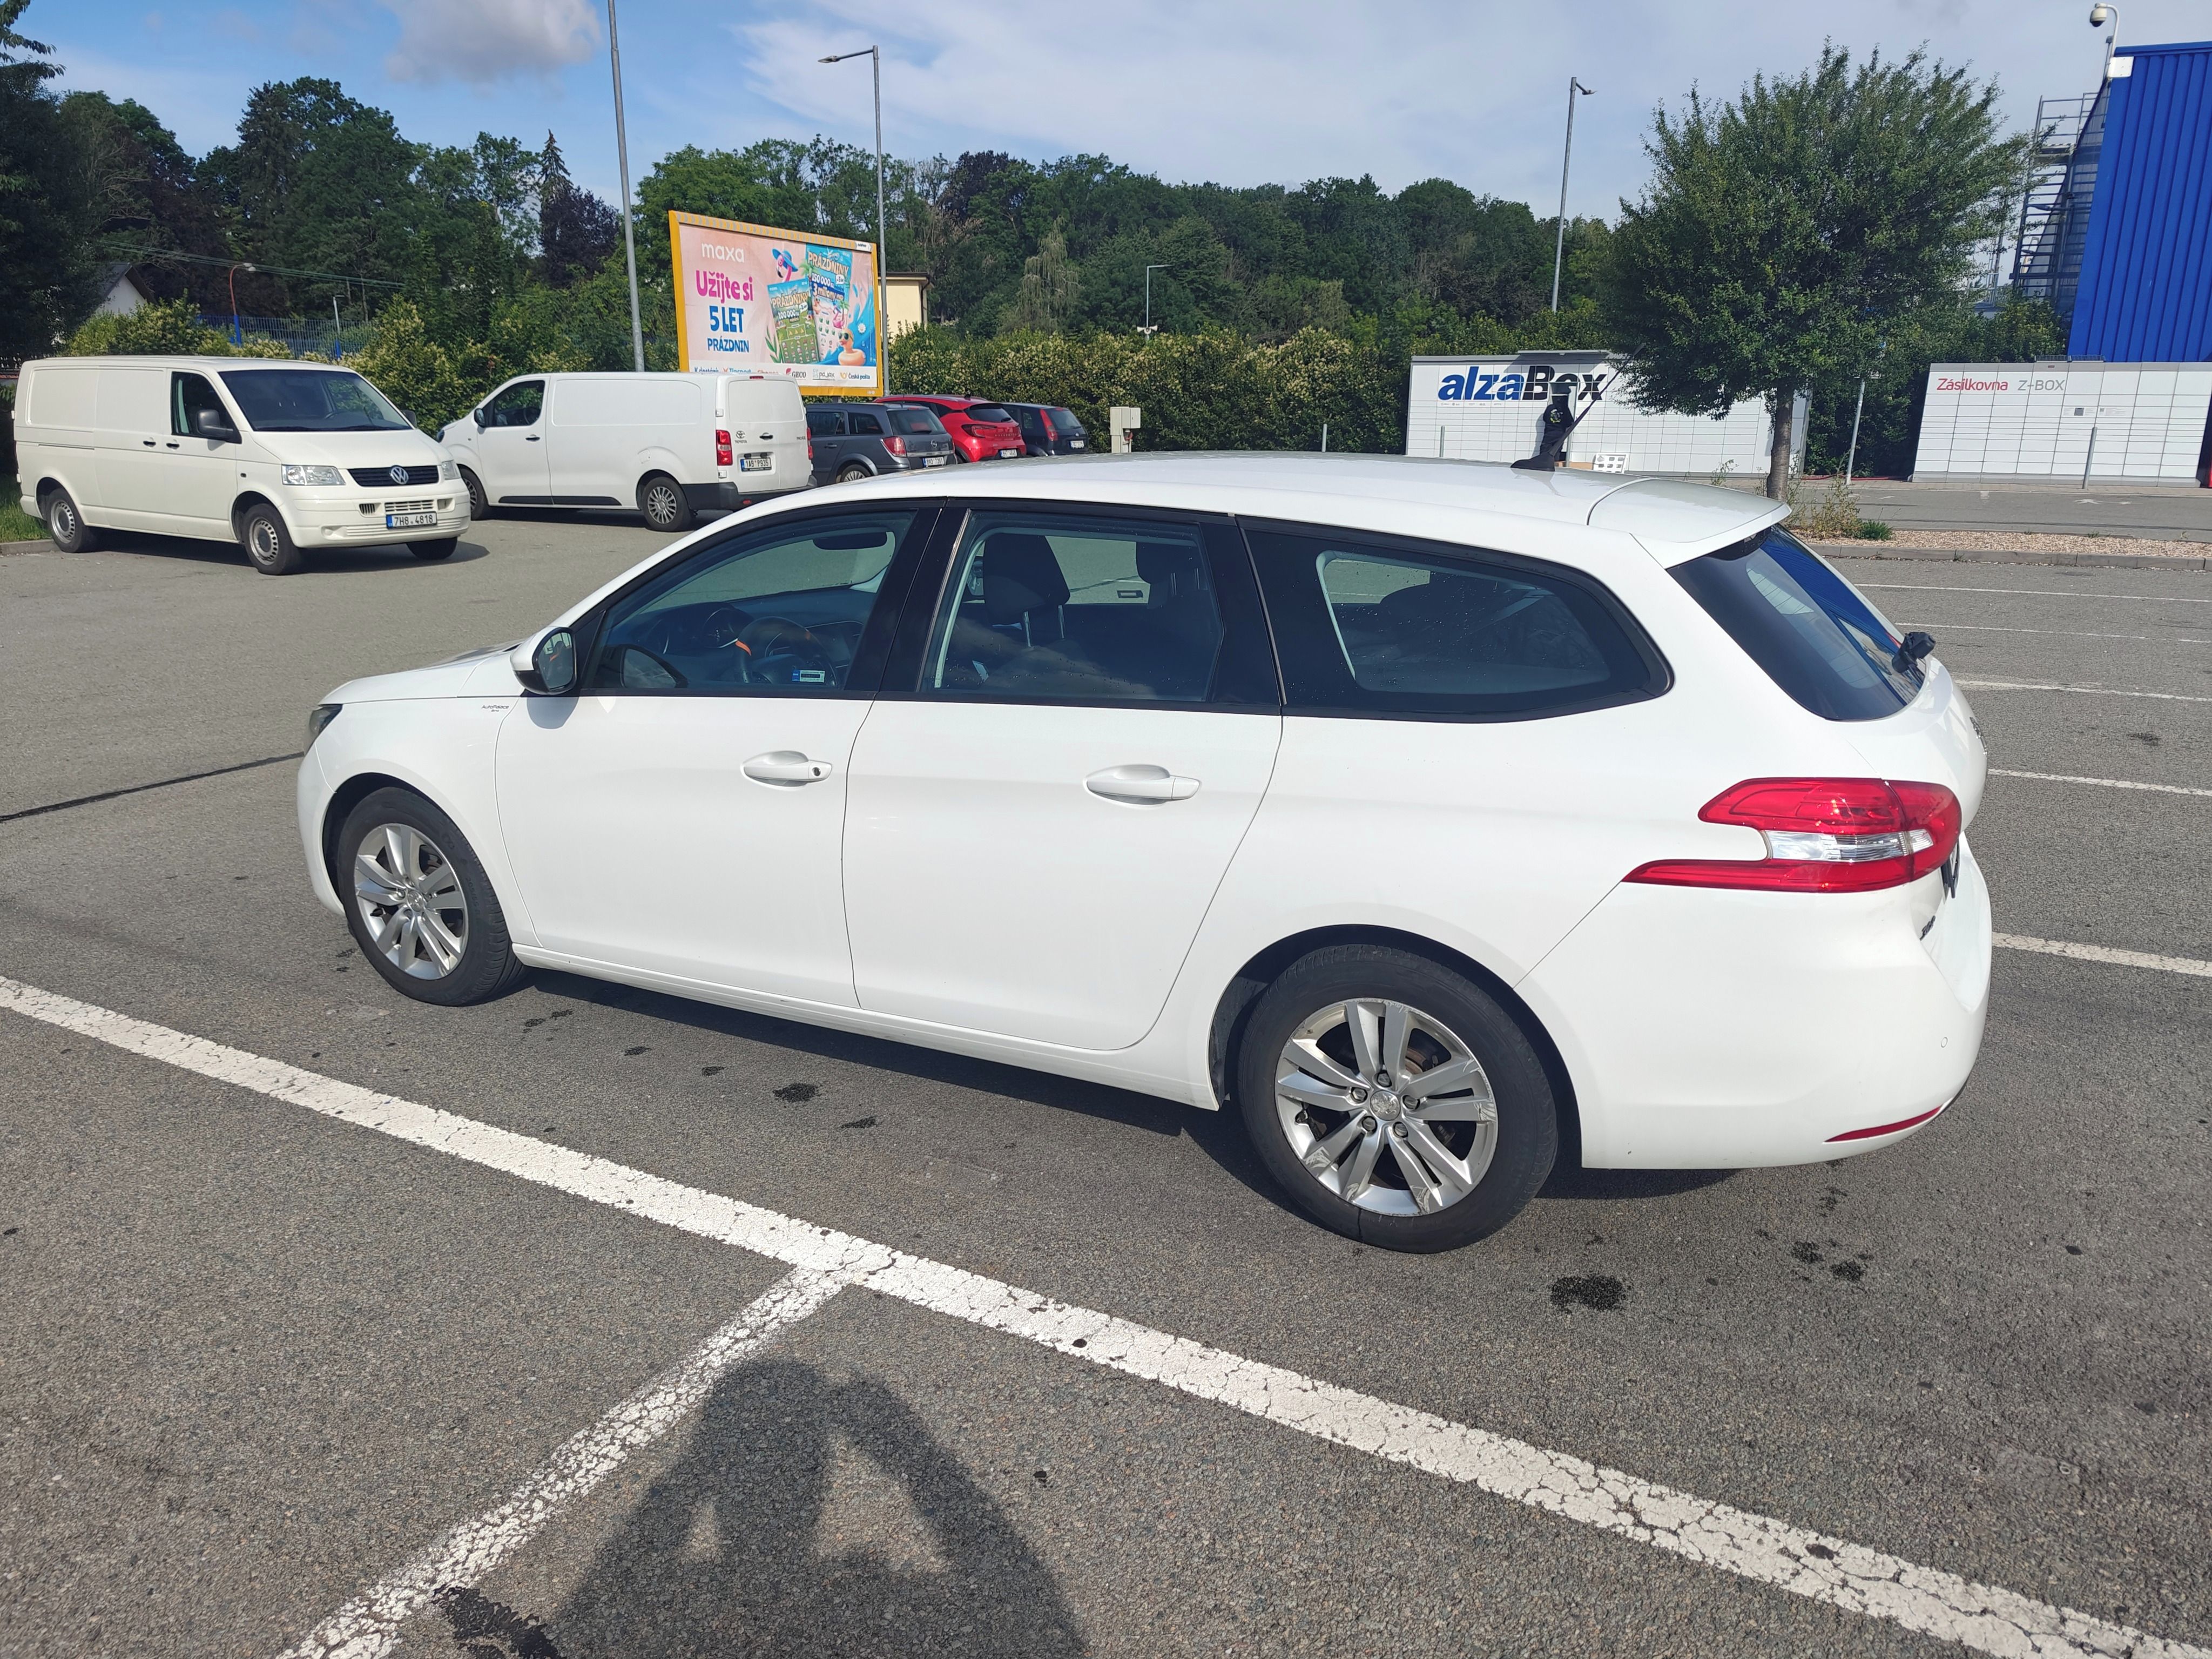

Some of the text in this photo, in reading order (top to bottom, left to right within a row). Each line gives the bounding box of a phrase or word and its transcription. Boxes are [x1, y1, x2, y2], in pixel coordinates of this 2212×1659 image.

[702, 242, 745, 263] maxa
[807, 251, 849, 277] PRÁZDNINY
[696, 270, 753, 304] Užijte si
[813, 283, 818, 296] 3
[772, 291, 809, 308] PRÁZDNINY
[709, 305, 744, 333] 5 LET
[778, 311, 786, 320] 100
[787, 309, 795, 318] 000
[707, 335, 750, 353] PRÁZDNIN
[1937, 378, 2066, 391] Zásilkovna Z-BOX
[394, 515, 433, 525] 7H8 4818
